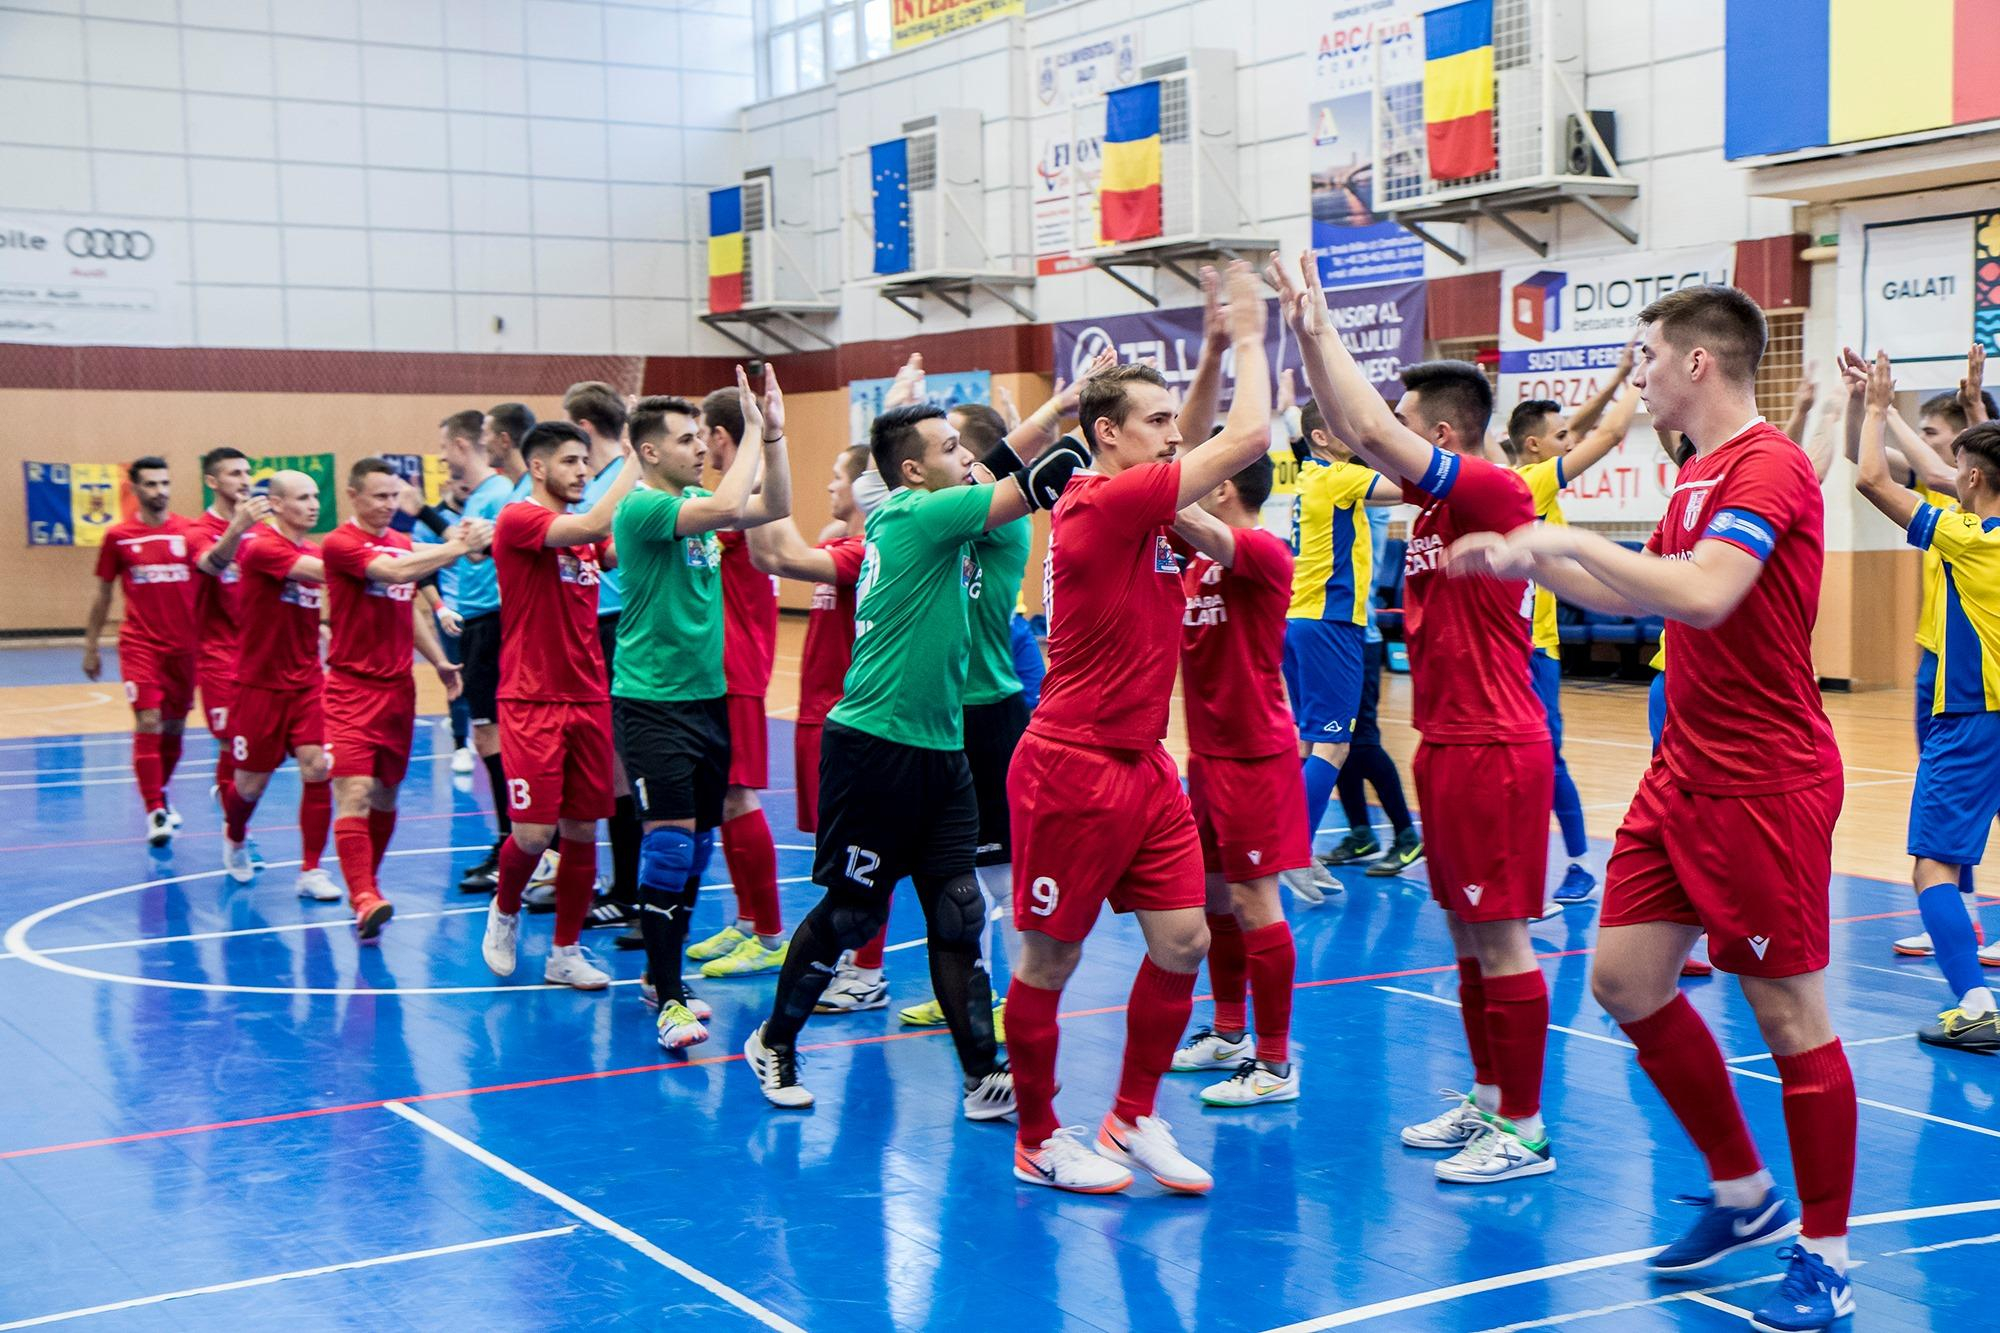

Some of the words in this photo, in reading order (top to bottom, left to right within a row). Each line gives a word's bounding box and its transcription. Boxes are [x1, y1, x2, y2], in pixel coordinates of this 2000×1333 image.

[1882, 275, 1955, 302] GALAȚI
[1379, 301, 1404, 324] AL
[1518, 376, 1601, 407] FORZA
[1559, 467, 1640, 508] ALAȚI
[233, 735, 249, 762] 8
[635, 777, 649, 811] 1
[845, 844, 881, 888] 12
[1030, 876, 1060, 917] 9
